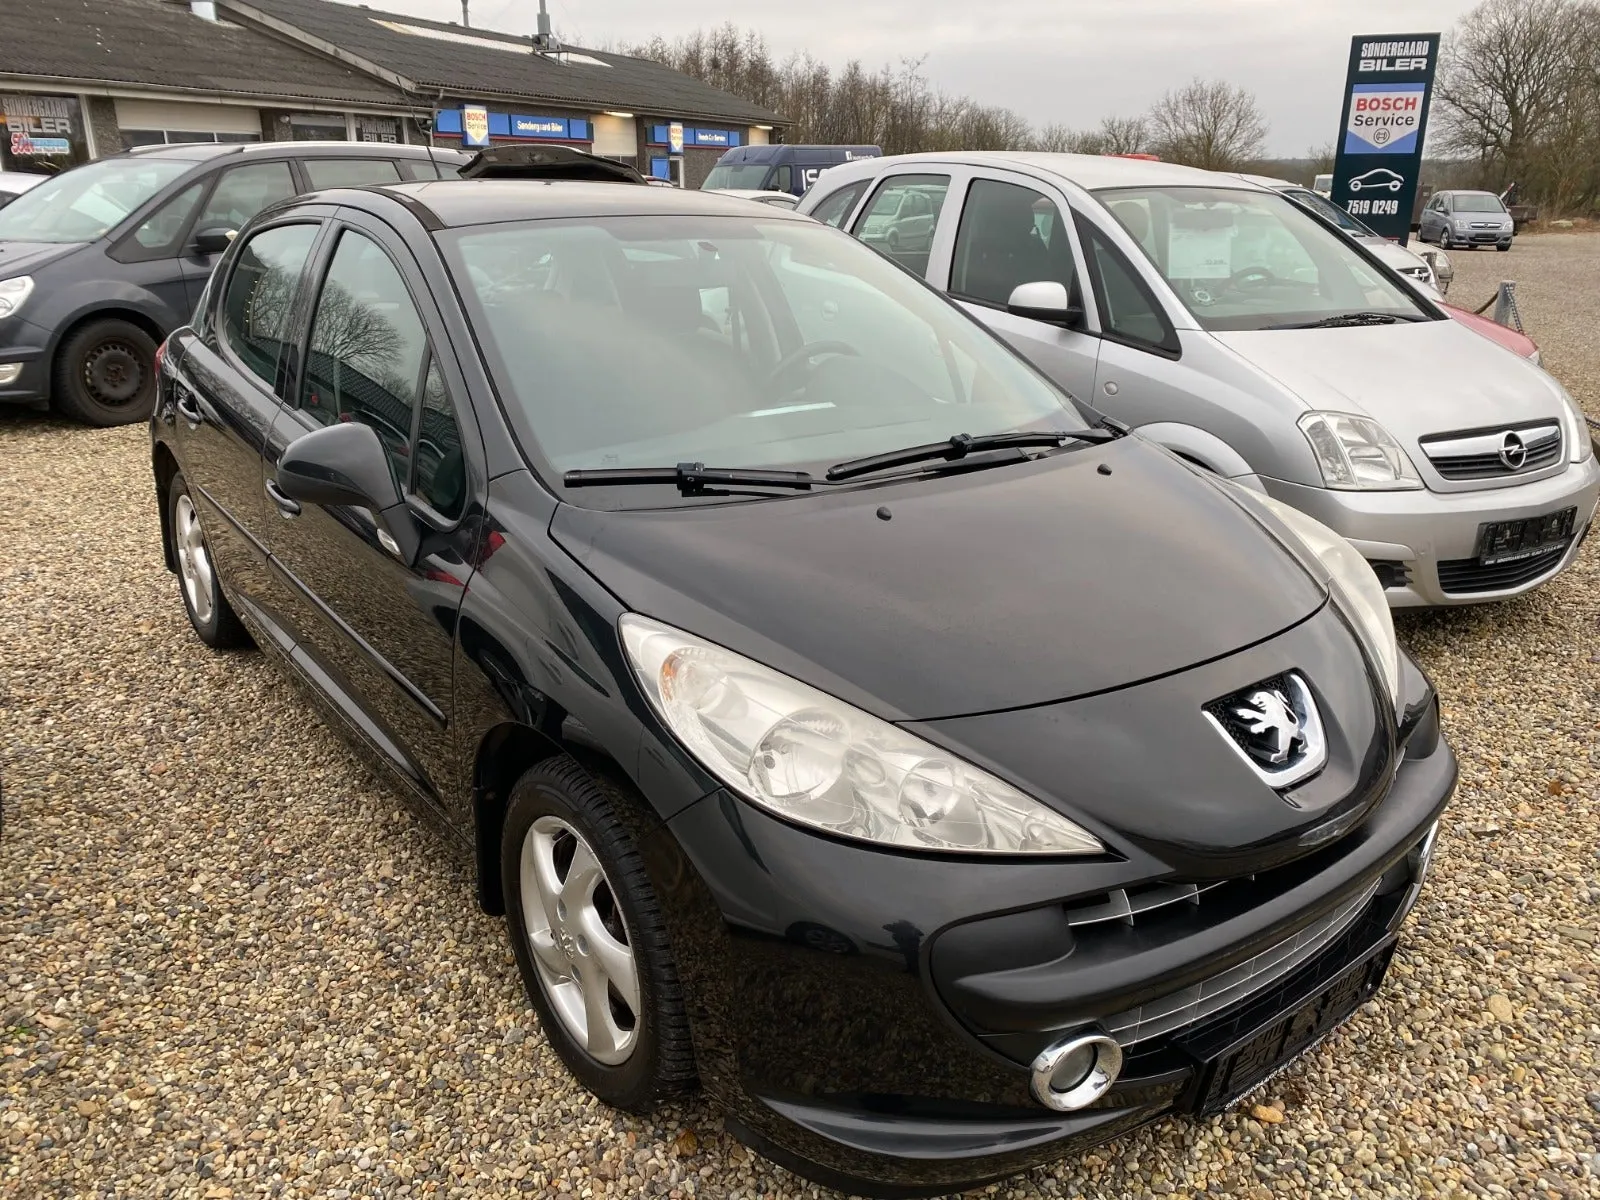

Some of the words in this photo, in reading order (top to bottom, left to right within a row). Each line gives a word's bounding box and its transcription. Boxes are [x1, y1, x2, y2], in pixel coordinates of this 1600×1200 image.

[1361, 41, 1429, 57] SØNDERGAARD
[1359, 58, 1427, 71] BILER
[1356, 97, 1418, 112] BOSCH
[466, 112, 486, 121] BOSCH
[1354, 113, 1415, 127] Service
[7, 117, 72, 133] BILER
[467, 121, 487, 130] Service
[1347, 200, 1369, 214] 7519
[1372, 200, 1398, 215] 0249
